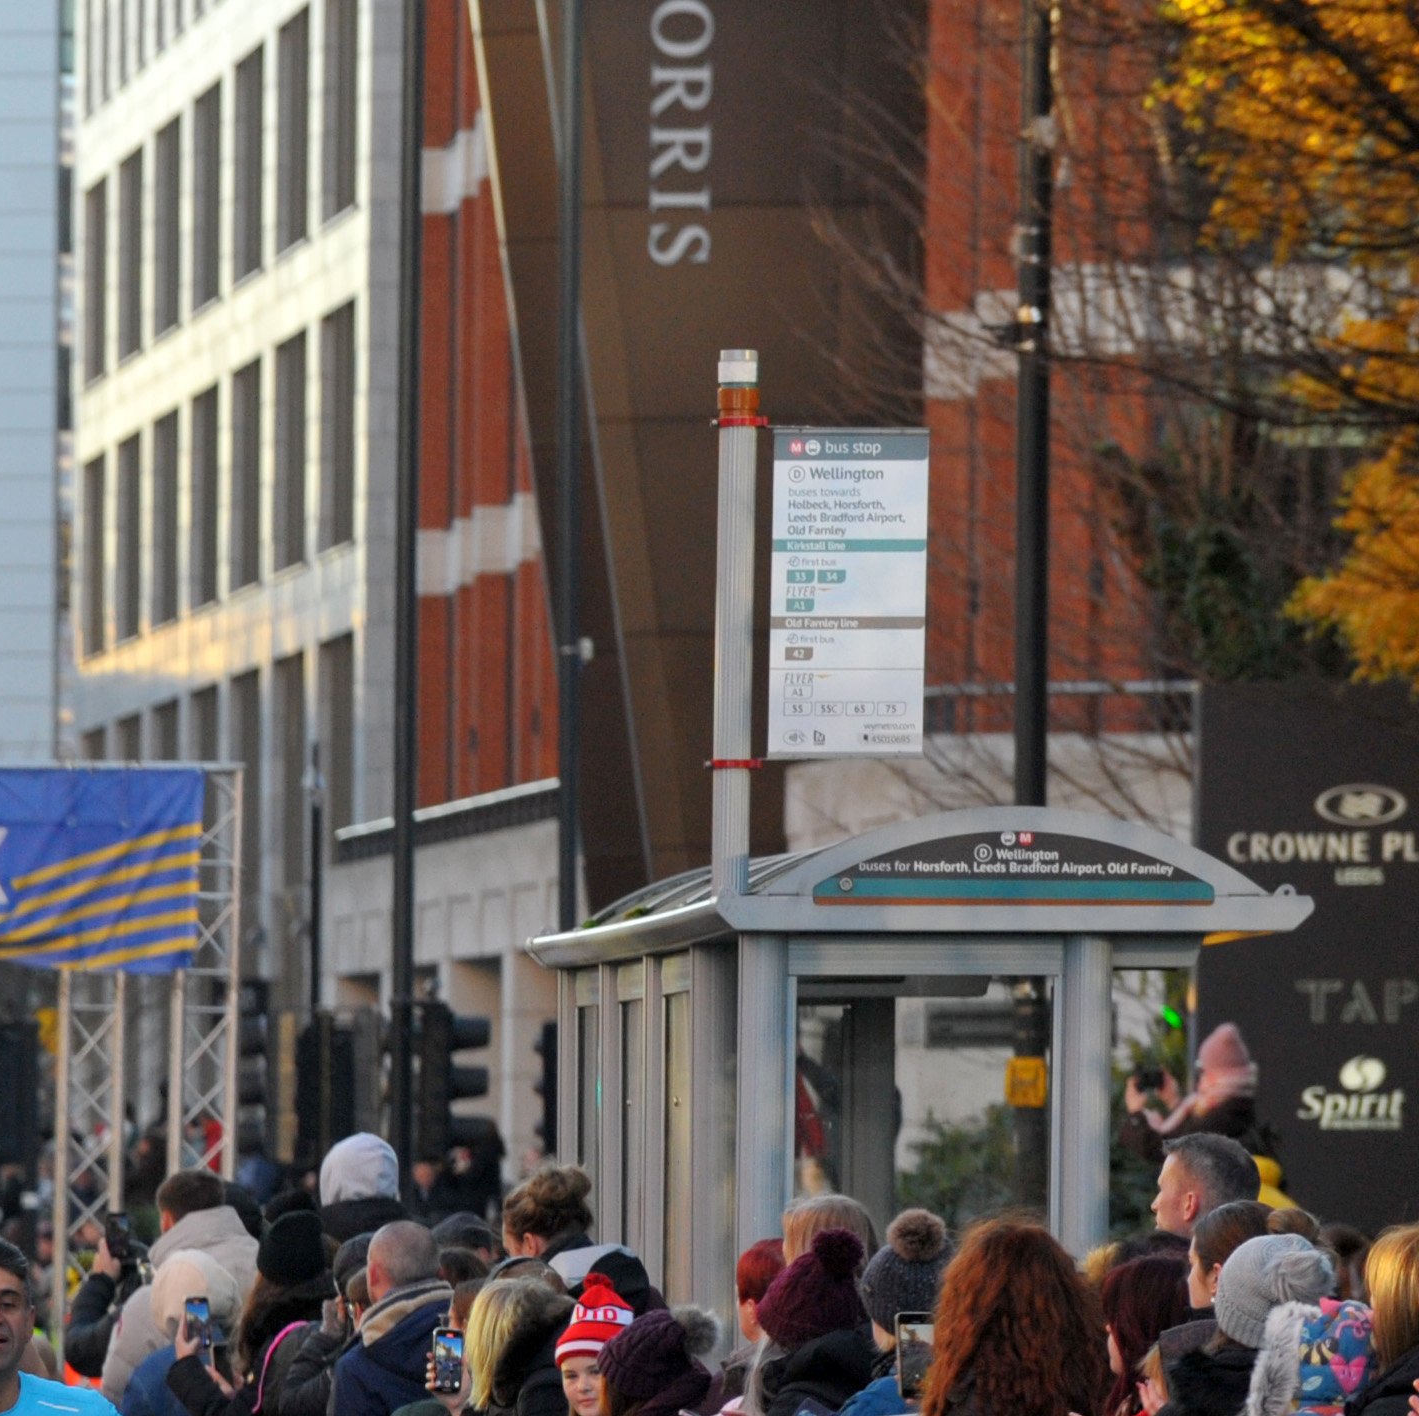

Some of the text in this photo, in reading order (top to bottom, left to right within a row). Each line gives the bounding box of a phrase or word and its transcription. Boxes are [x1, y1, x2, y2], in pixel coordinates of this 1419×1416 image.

[825, 440, 848, 454] bus
[853, 441, 881, 456] stop
[809, 467, 884, 483] Wellington
[788, 487, 861, 497] buses towards
[788, 500, 886, 511] Holbeck, Horsforth,
[788, 513, 906, 525] Leeds Bradford Airport,
[787, 526, 846, 537] Old Farnley
[787, 541, 845, 551] Kirkstall line
[821, 558, 836, 566] bus
[827, 573, 838, 581] 34
[786, 586, 816, 597] FLYER
[793, 601, 805, 609] A1
[785, 619, 859, 630] Old Farnley line
[820, 634, 835, 643] bus
[793, 650, 804, 658] 42
[785, 673, 813, 684] FLYER
[792, 688, 803, 697] A1
[863, 723, 916, 731] wymetro.com
[1227, 831, 1370, 863] CROWNE
[995, 849, 1059, 862] Wellington
[894, 861, 910, 871] for
[913, 861, 971, 874] Horsforth,
[974, 862, 1006, 872] Leeds
[1009, 862, 1059, 873] Bradford
[1061, 863, 1105, 876] Airport,
[1107, 863, 1128, 874] Old
[1131, 863, 1174, 877] Farnley
[1296, 1085, 1405, 1130] Spirit
